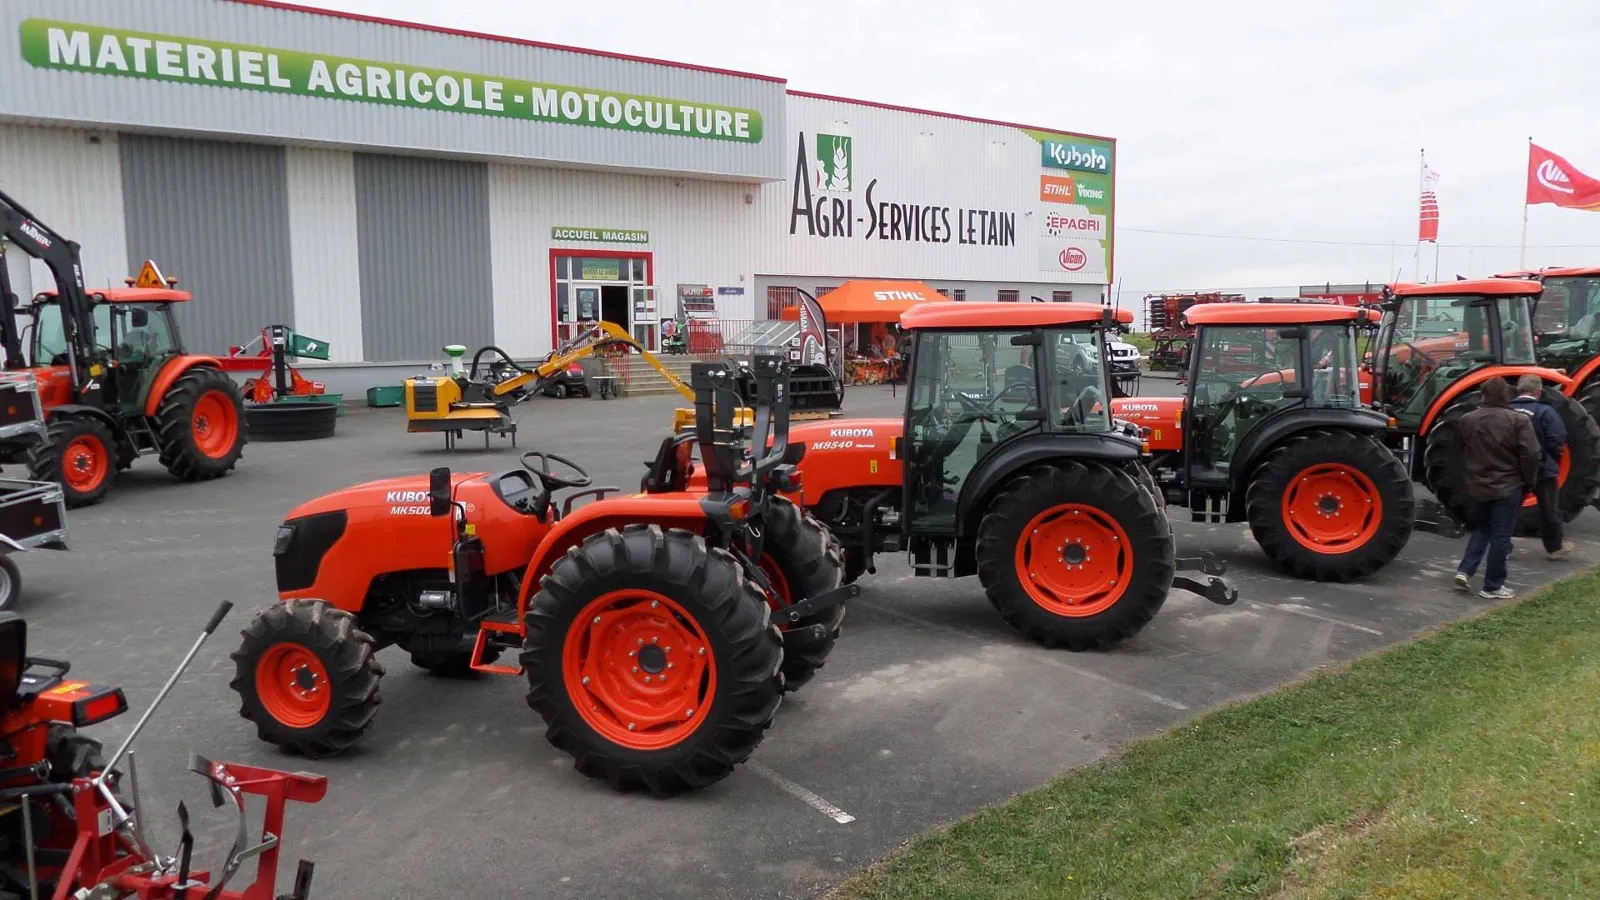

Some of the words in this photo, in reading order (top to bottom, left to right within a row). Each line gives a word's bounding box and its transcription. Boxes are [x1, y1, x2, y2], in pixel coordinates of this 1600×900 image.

[48, 28, 291, 88] MATERIEL
[307, 60, 504, 111] AGRICOLE
[532, 87, 750, 138] MOTOCULTURE
[1044, 183, 1071, 196] STIHL
[1078, 187, 1103, 199] VIKING
[958, 208, 1015, 248] LETAIN
[1051, 217, 1100, 231] EPAGRI
[555, 229, 599, 240] ACCUEIL
[602, 231, 647, 242] MAGASIN
[1063, 249, 1083, 265] Vicon
[873, 291, 925, 301] STIHL
[830, 428, 874, 437] KUBOTA
[812, 441, 853, 450] M8540
[386, 491, 431, 502] KUBO
[390, 506, 431, 515] MK500
